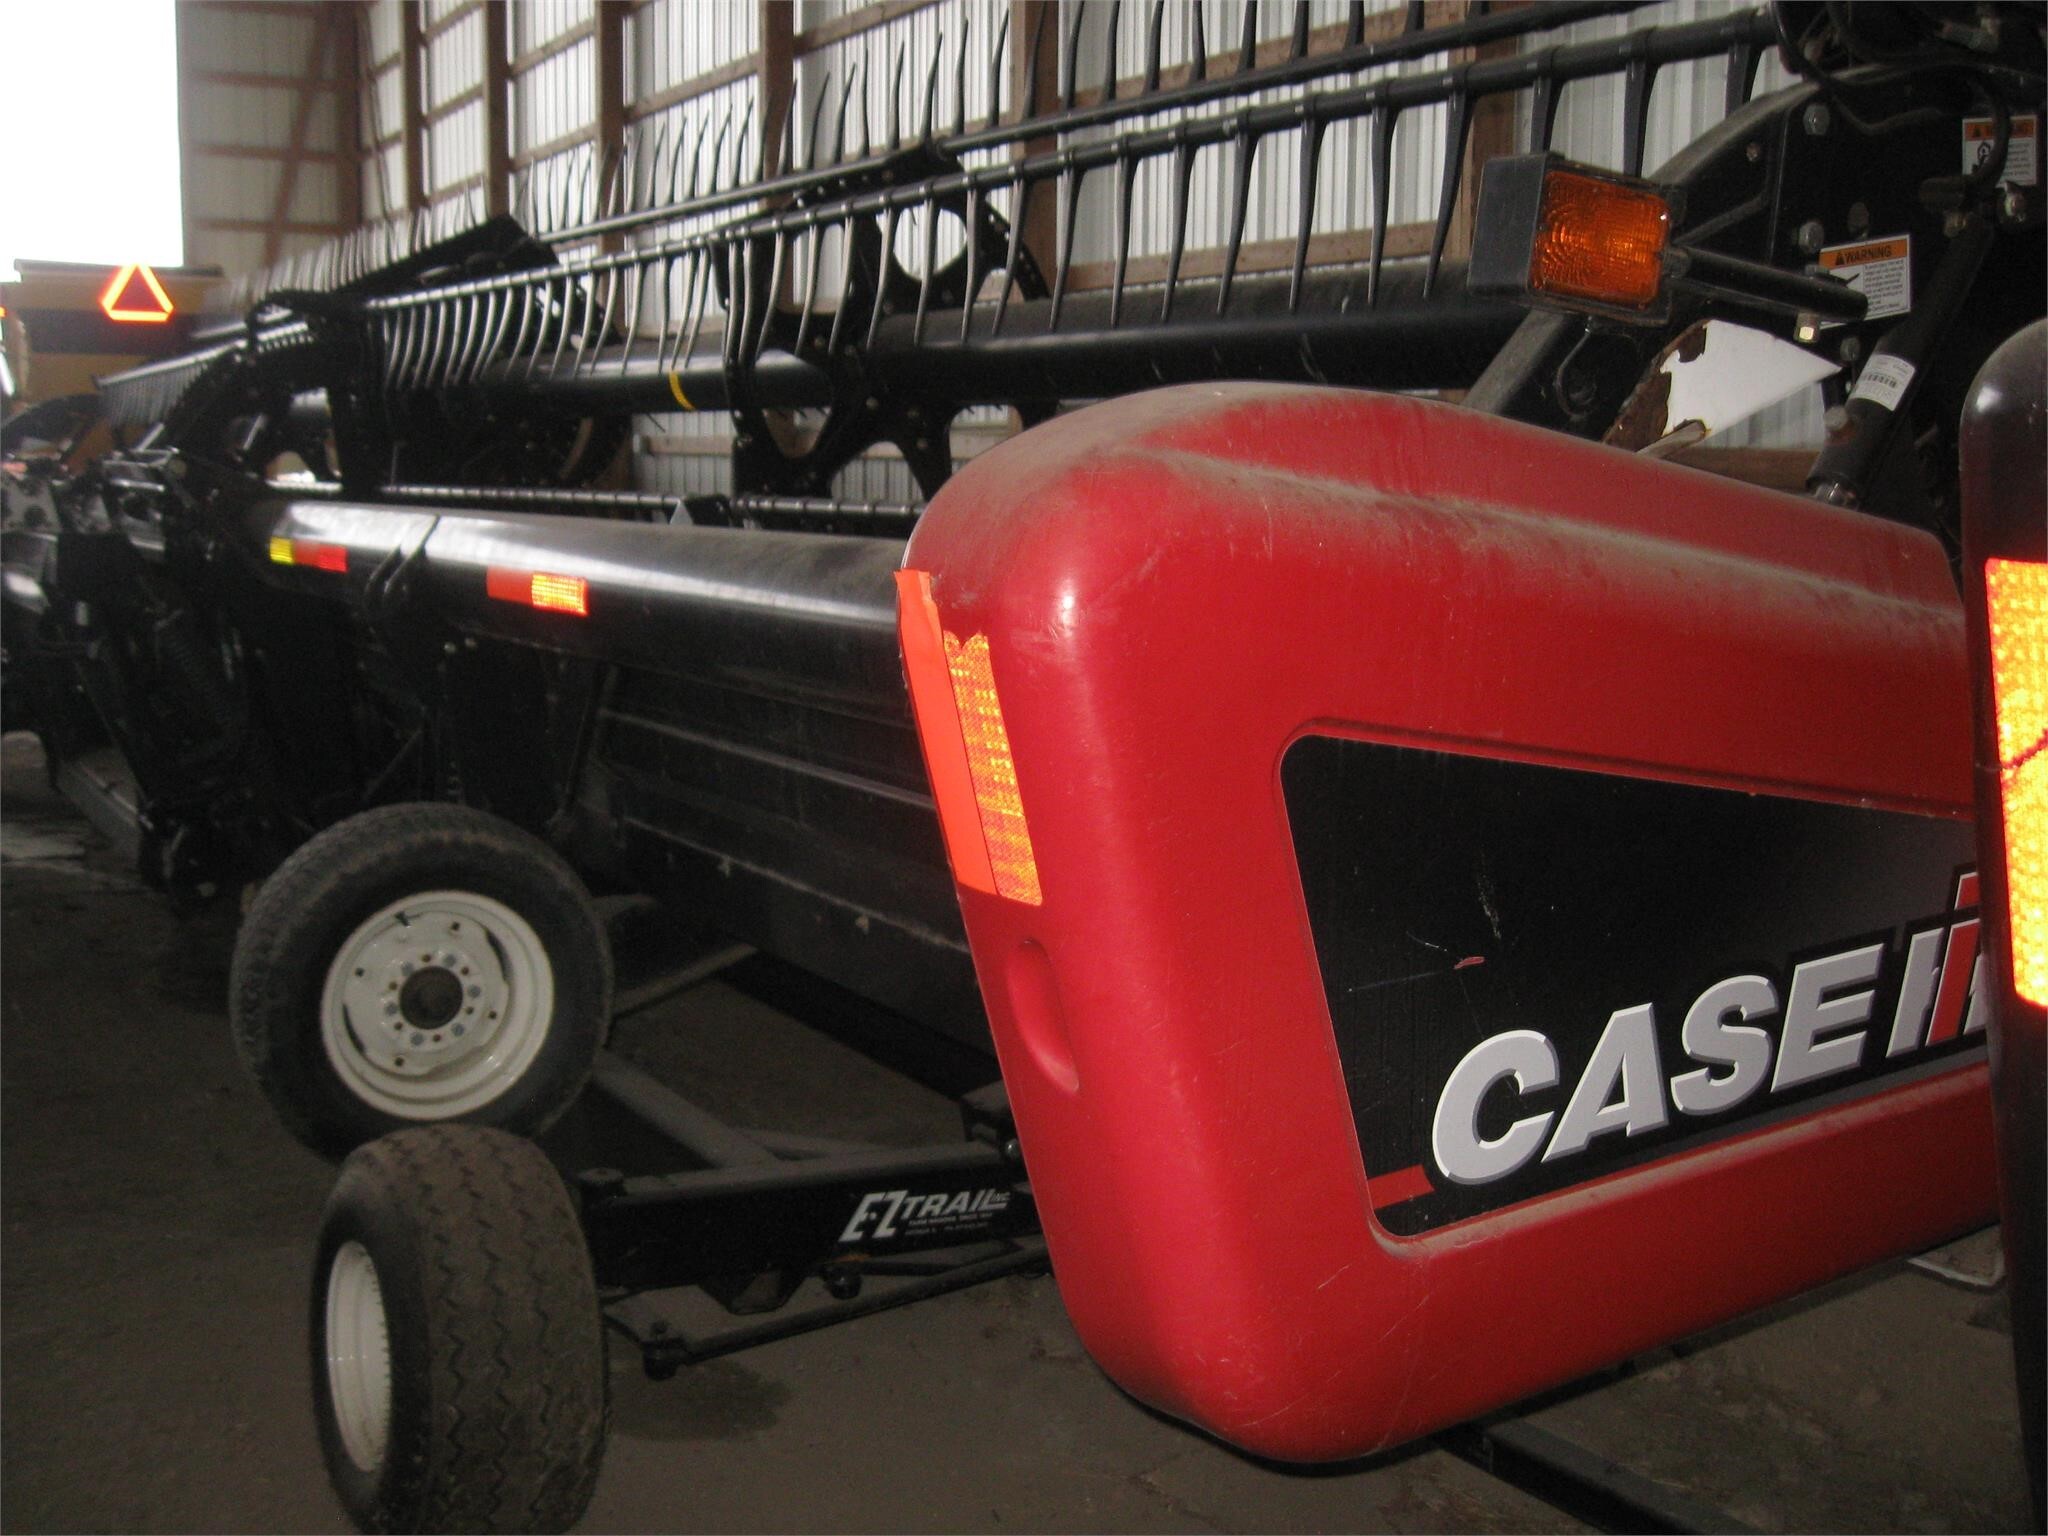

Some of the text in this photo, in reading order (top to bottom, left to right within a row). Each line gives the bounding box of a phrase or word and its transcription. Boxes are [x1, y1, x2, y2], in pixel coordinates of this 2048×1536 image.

[1845, 245, 1892, 264] WARNING
[1431, 942, 1886, 1186] CASE
[900, 1188, 1008, 1220] TRAIL
